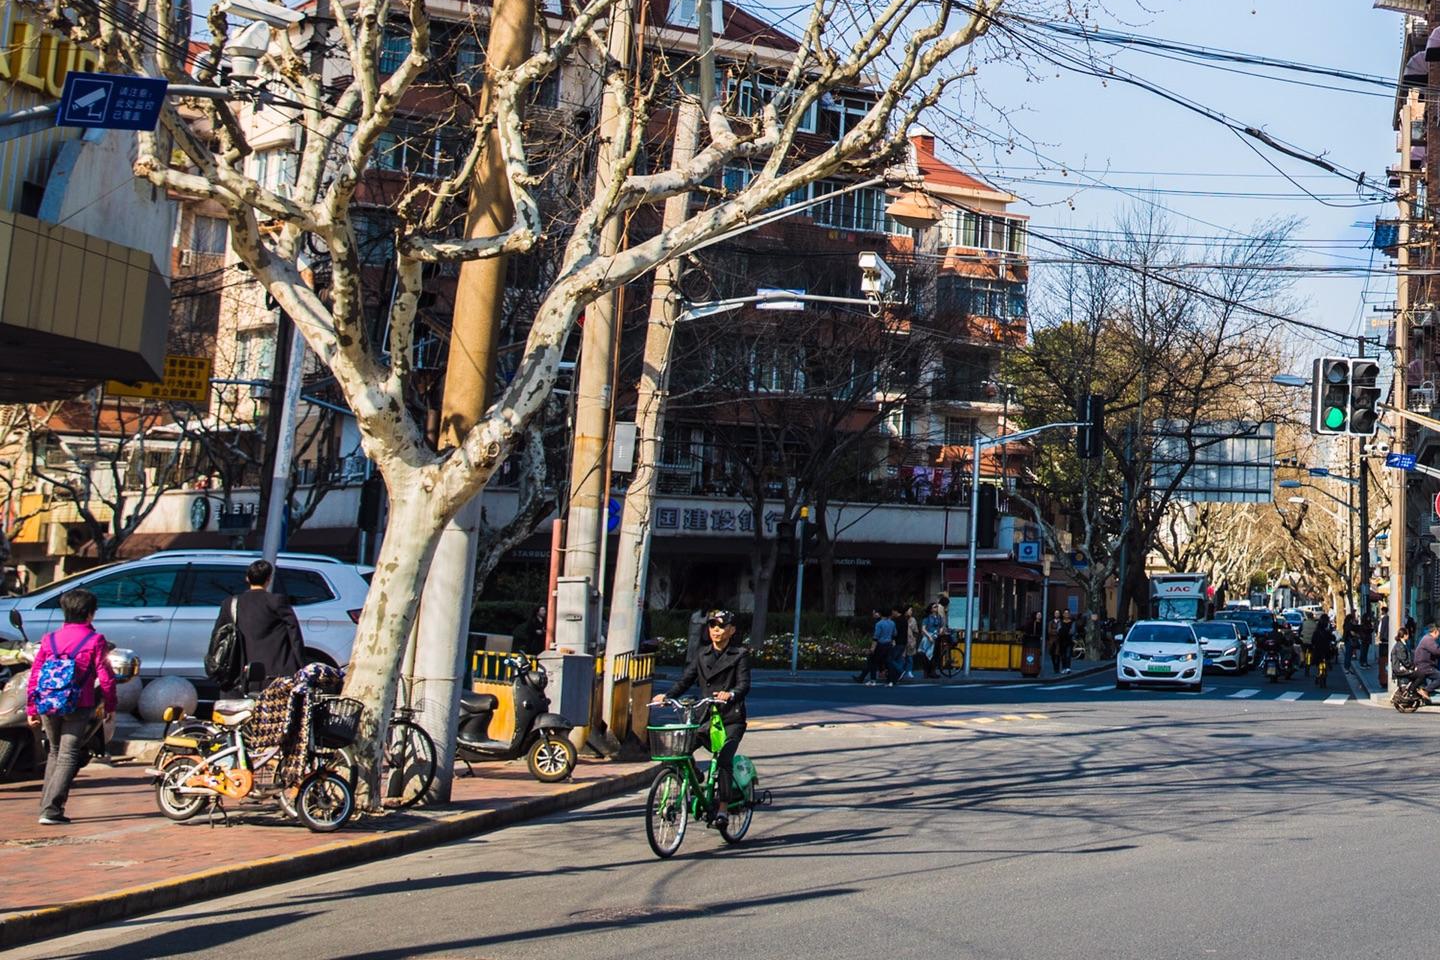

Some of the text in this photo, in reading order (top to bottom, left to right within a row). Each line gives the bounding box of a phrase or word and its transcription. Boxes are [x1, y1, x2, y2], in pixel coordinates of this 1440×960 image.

[656, 507, 785, 532] 国建设银行
